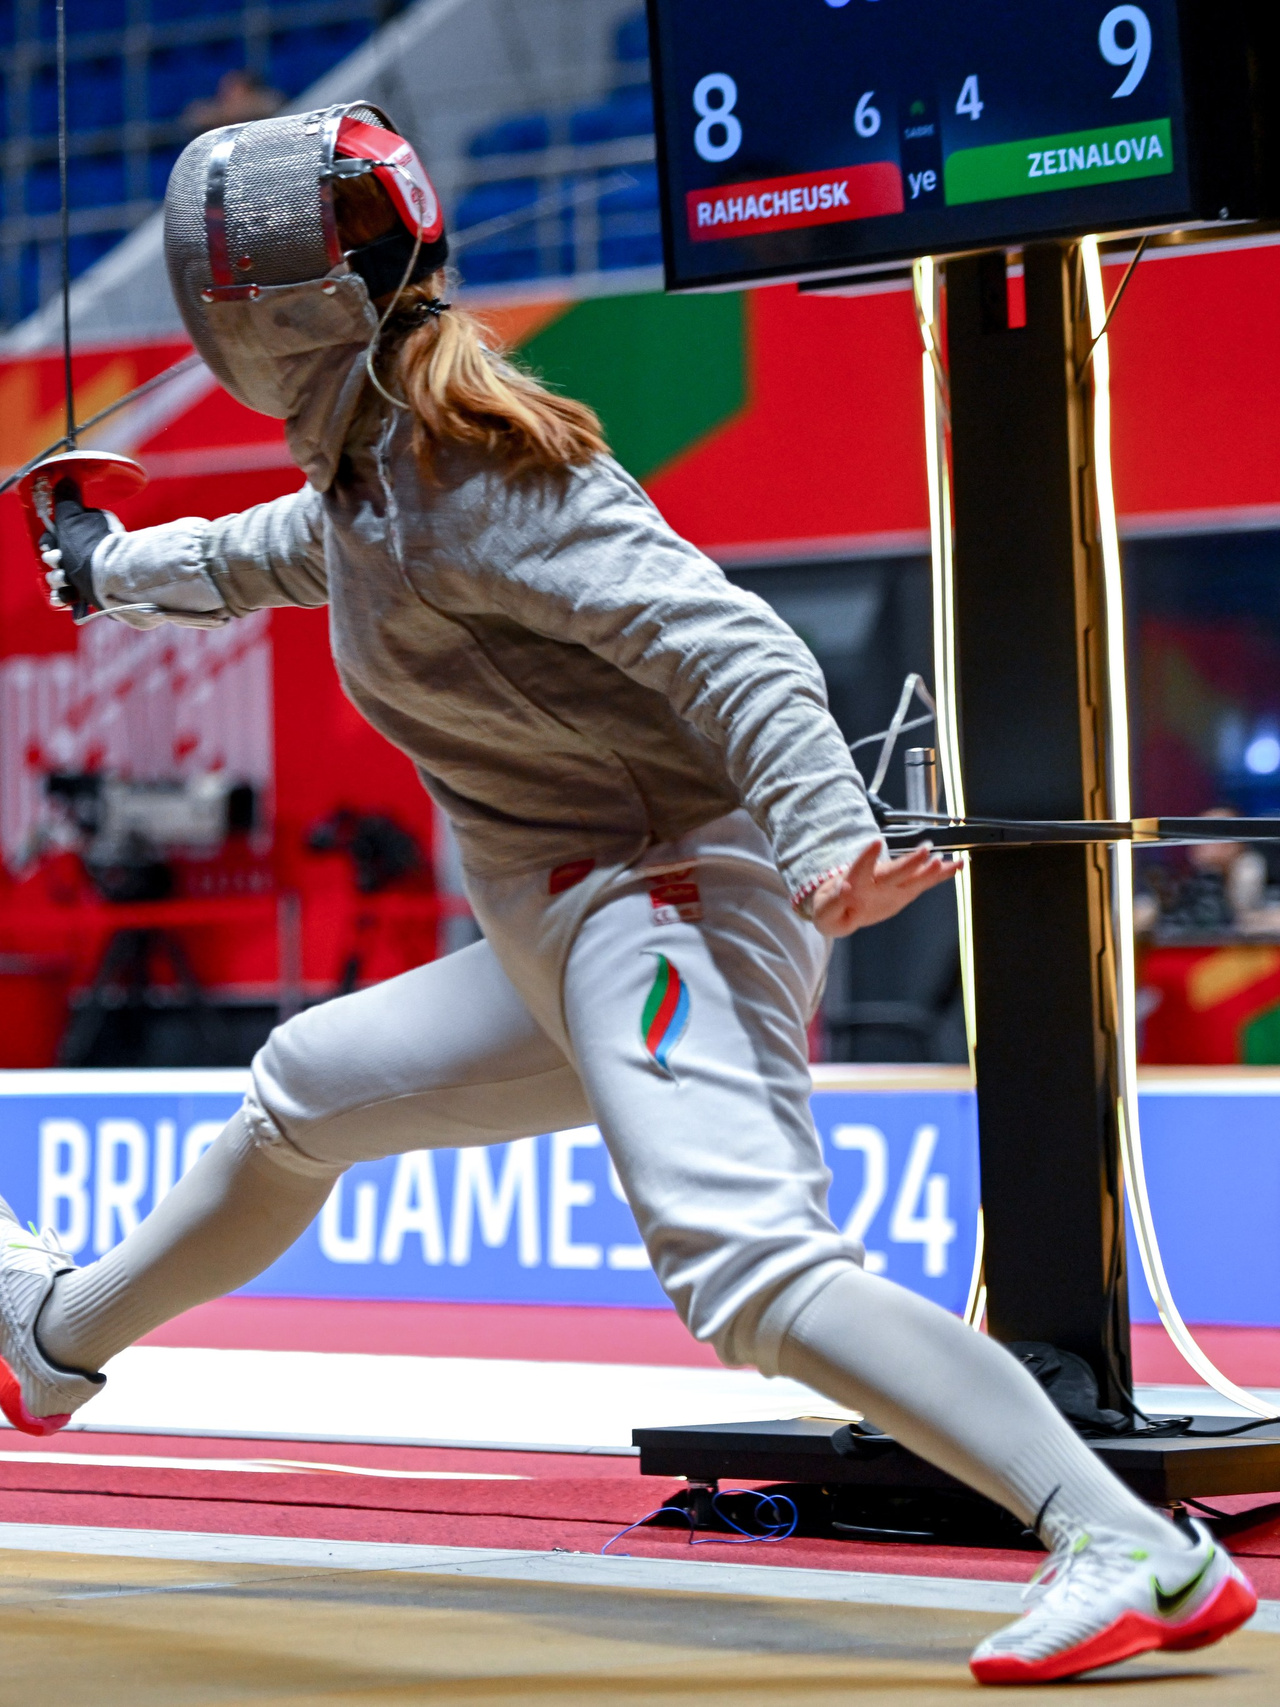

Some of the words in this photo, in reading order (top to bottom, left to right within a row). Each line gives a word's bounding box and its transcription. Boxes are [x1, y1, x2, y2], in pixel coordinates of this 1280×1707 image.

[1097, 5, 1151, 98] 9
[692, 72, 742, 163] 8
[853, 92, 881, 138] 6
[955, 75, 984, 121] 4
[1027, 134, 1164, 178] ZEINALOVA
[696, 180, 850, 227] RAHACHEUSK
[908, 169, 937, 200] ye
